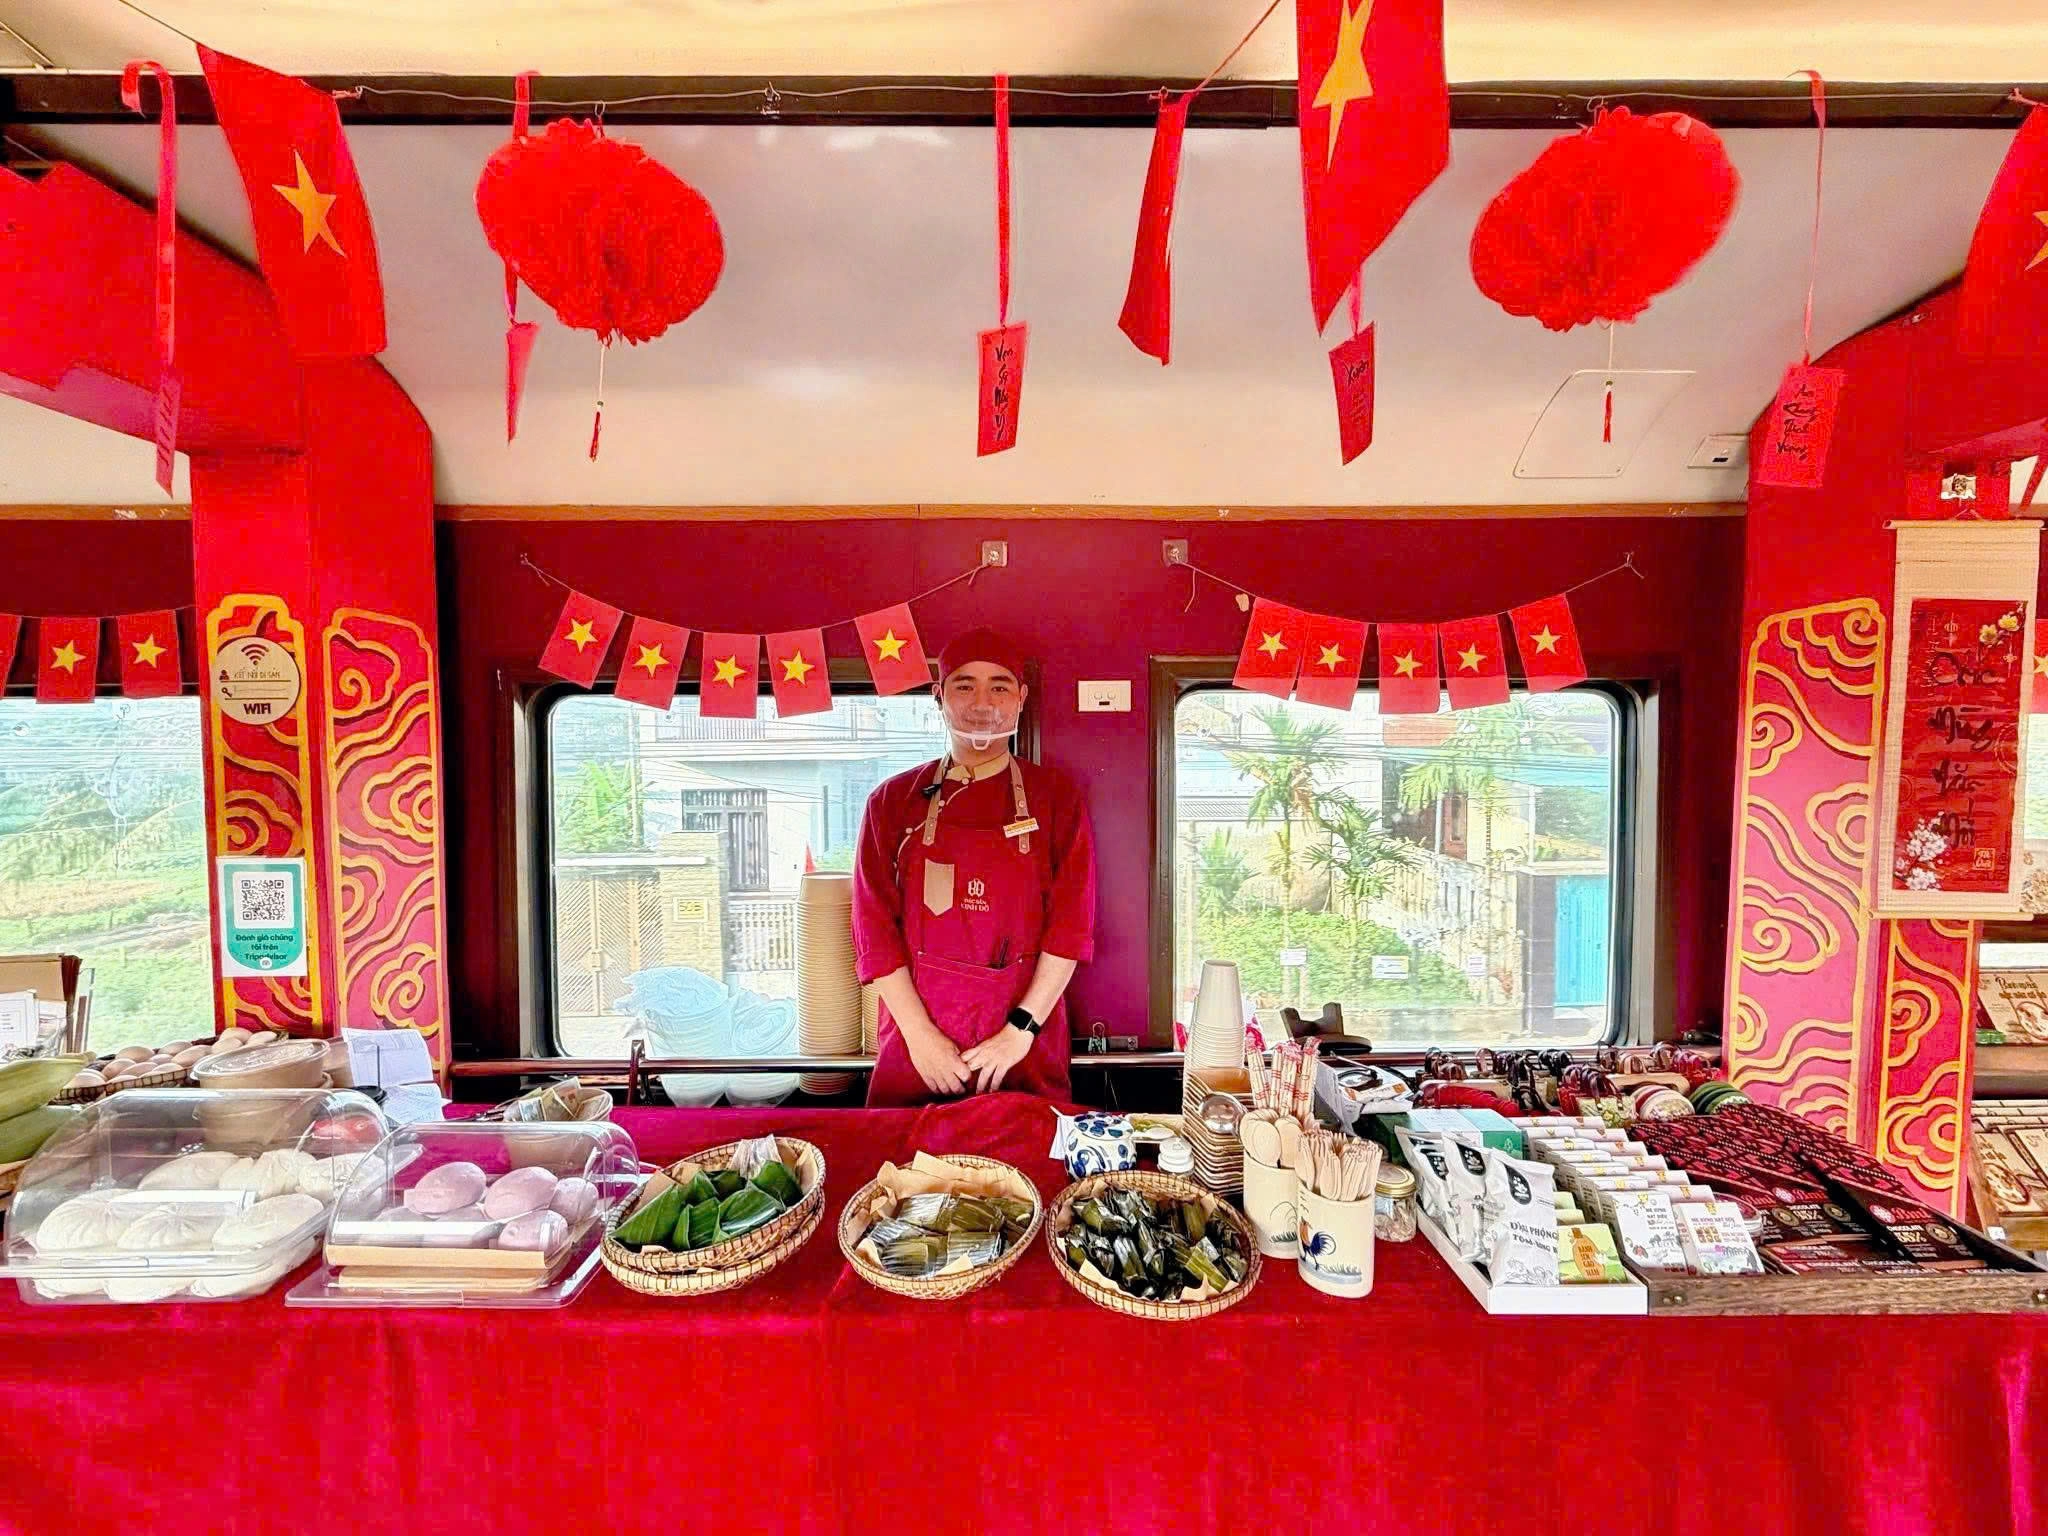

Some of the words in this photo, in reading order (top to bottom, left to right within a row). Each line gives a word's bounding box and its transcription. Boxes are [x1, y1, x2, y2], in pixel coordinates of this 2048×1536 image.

[243, 703, 271, 714] WIFI
[257, 934, 269, 942] giá
[270, 933, 294, 942] chúng
